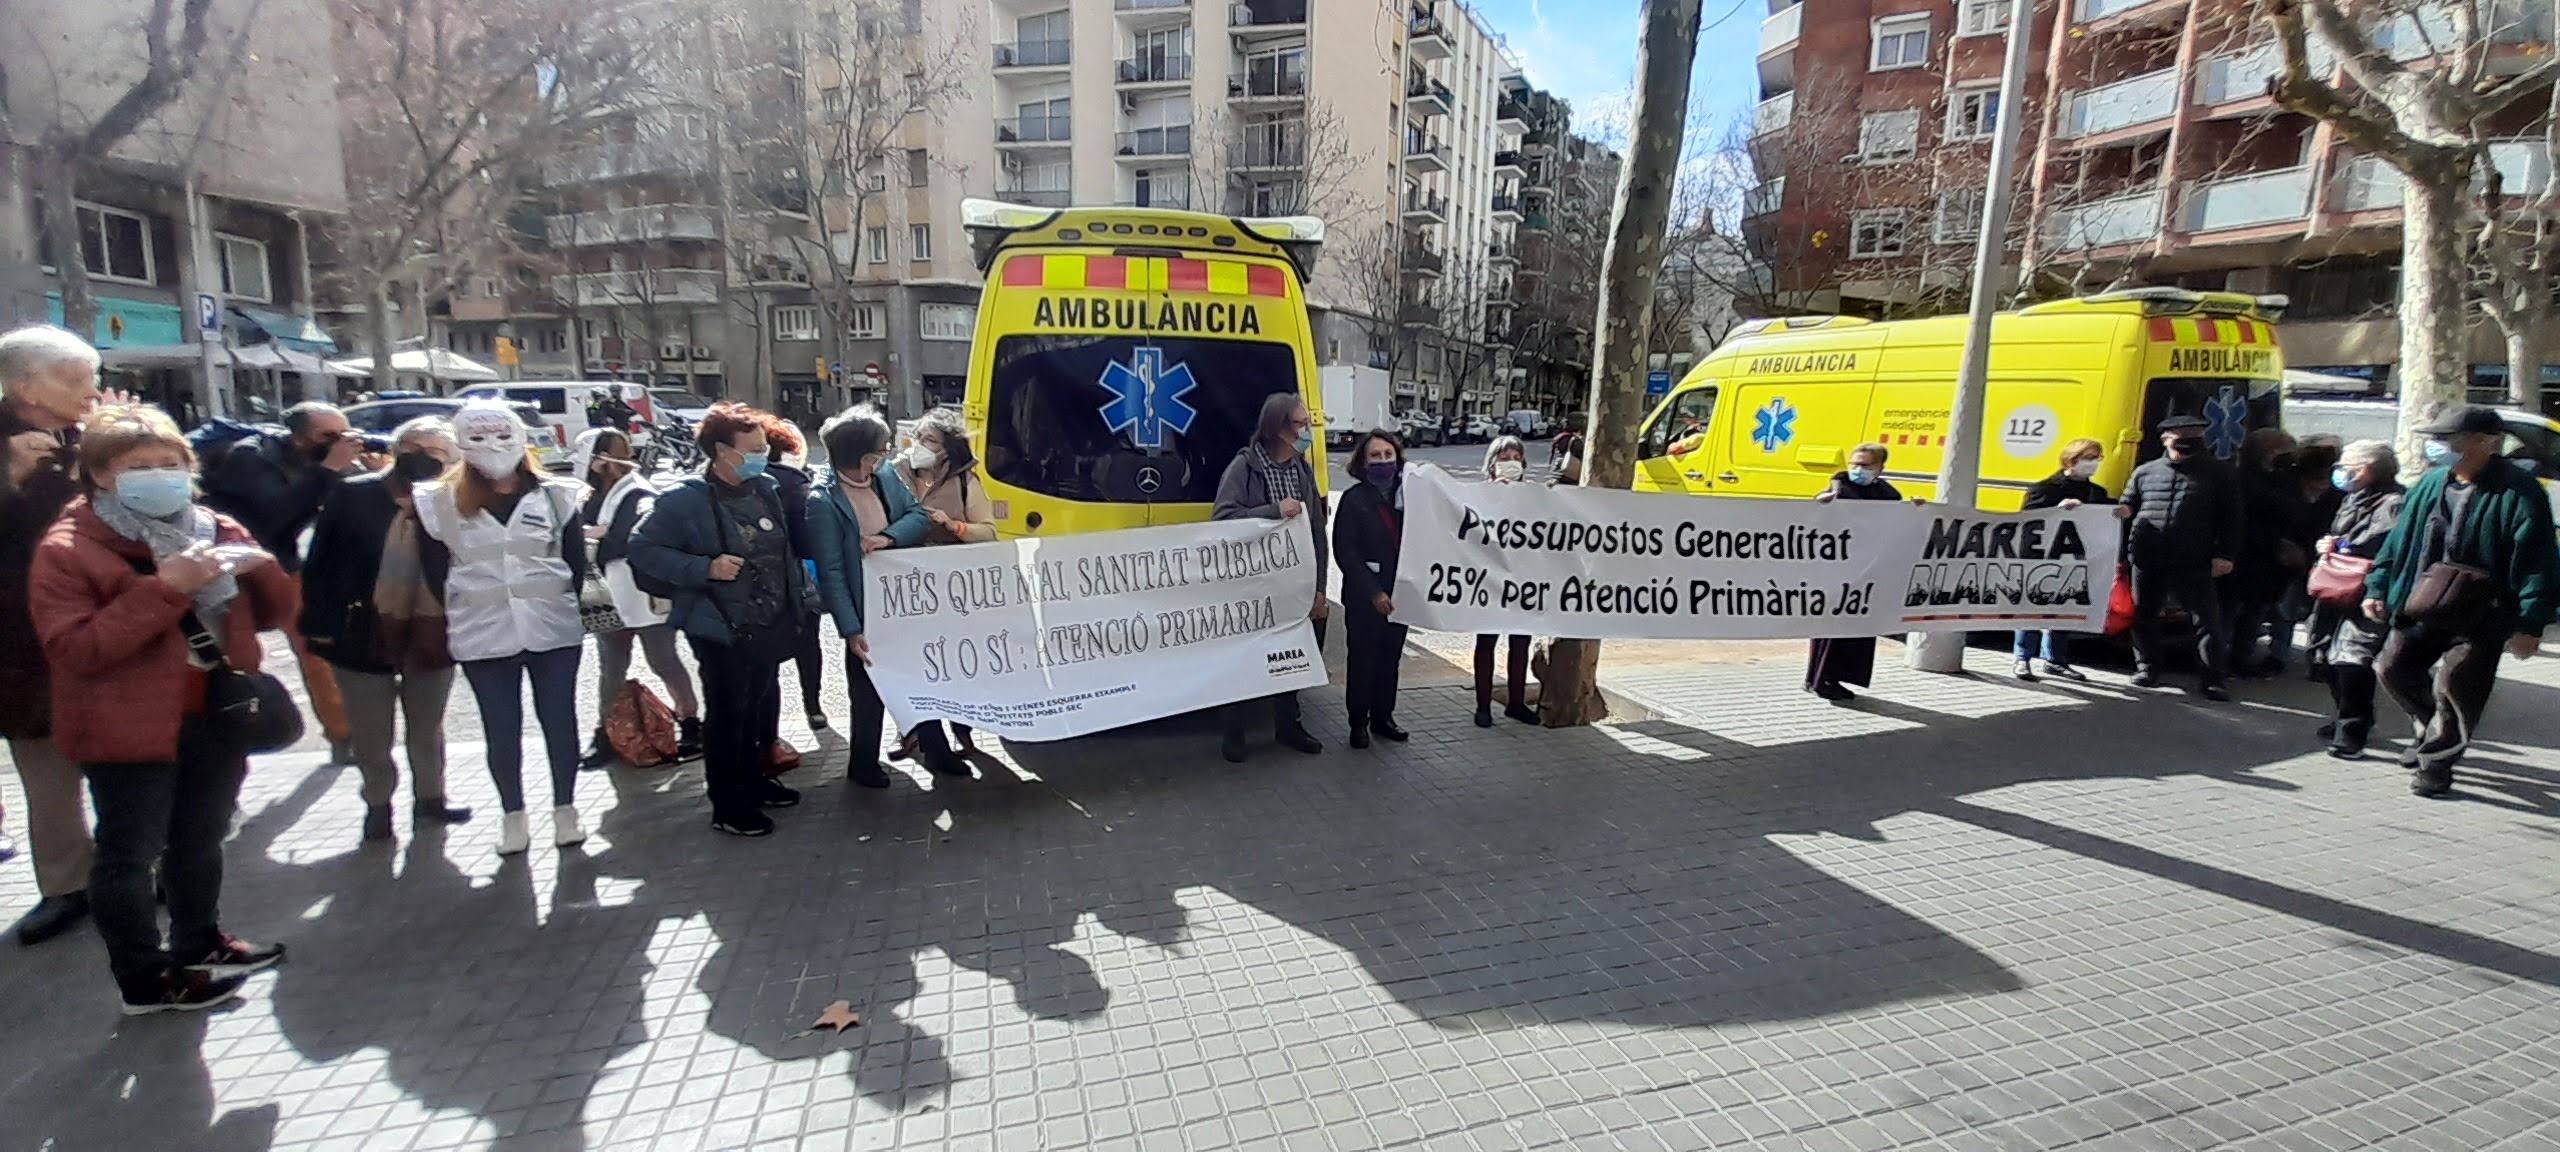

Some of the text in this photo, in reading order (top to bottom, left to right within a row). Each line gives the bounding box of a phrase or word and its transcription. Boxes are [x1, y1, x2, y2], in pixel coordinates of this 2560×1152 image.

[201, 297, 214, 325] P
[1034, 293, 1260, 334] AMBULÀNCIA
[1747, 350, 1856, 375] AMBULÀNCIA
[2007, 418, 2046, 437] 112
[1458, 505, 1853, 561] Pressupostos Generalitat
[1922, 518, 2086, 560] MAREA
[948, 565, 1006, 617] QUE
[1011, 560, 1071, 605] MAL
[1077, 548, 1190, 598] SANITAT
[1196, 528, 1301, 584] PÚBLICA
[1427, 563, 1875, 617] 25% per Atenció Primària Ja!
[1904, 563, 2092, 607] BLANCA
[957, 638, 979, 680] O
[1036, 611, 1149, 669] ATENCIÓ
[1156, 596, 1276, 649] PRIMARIA
